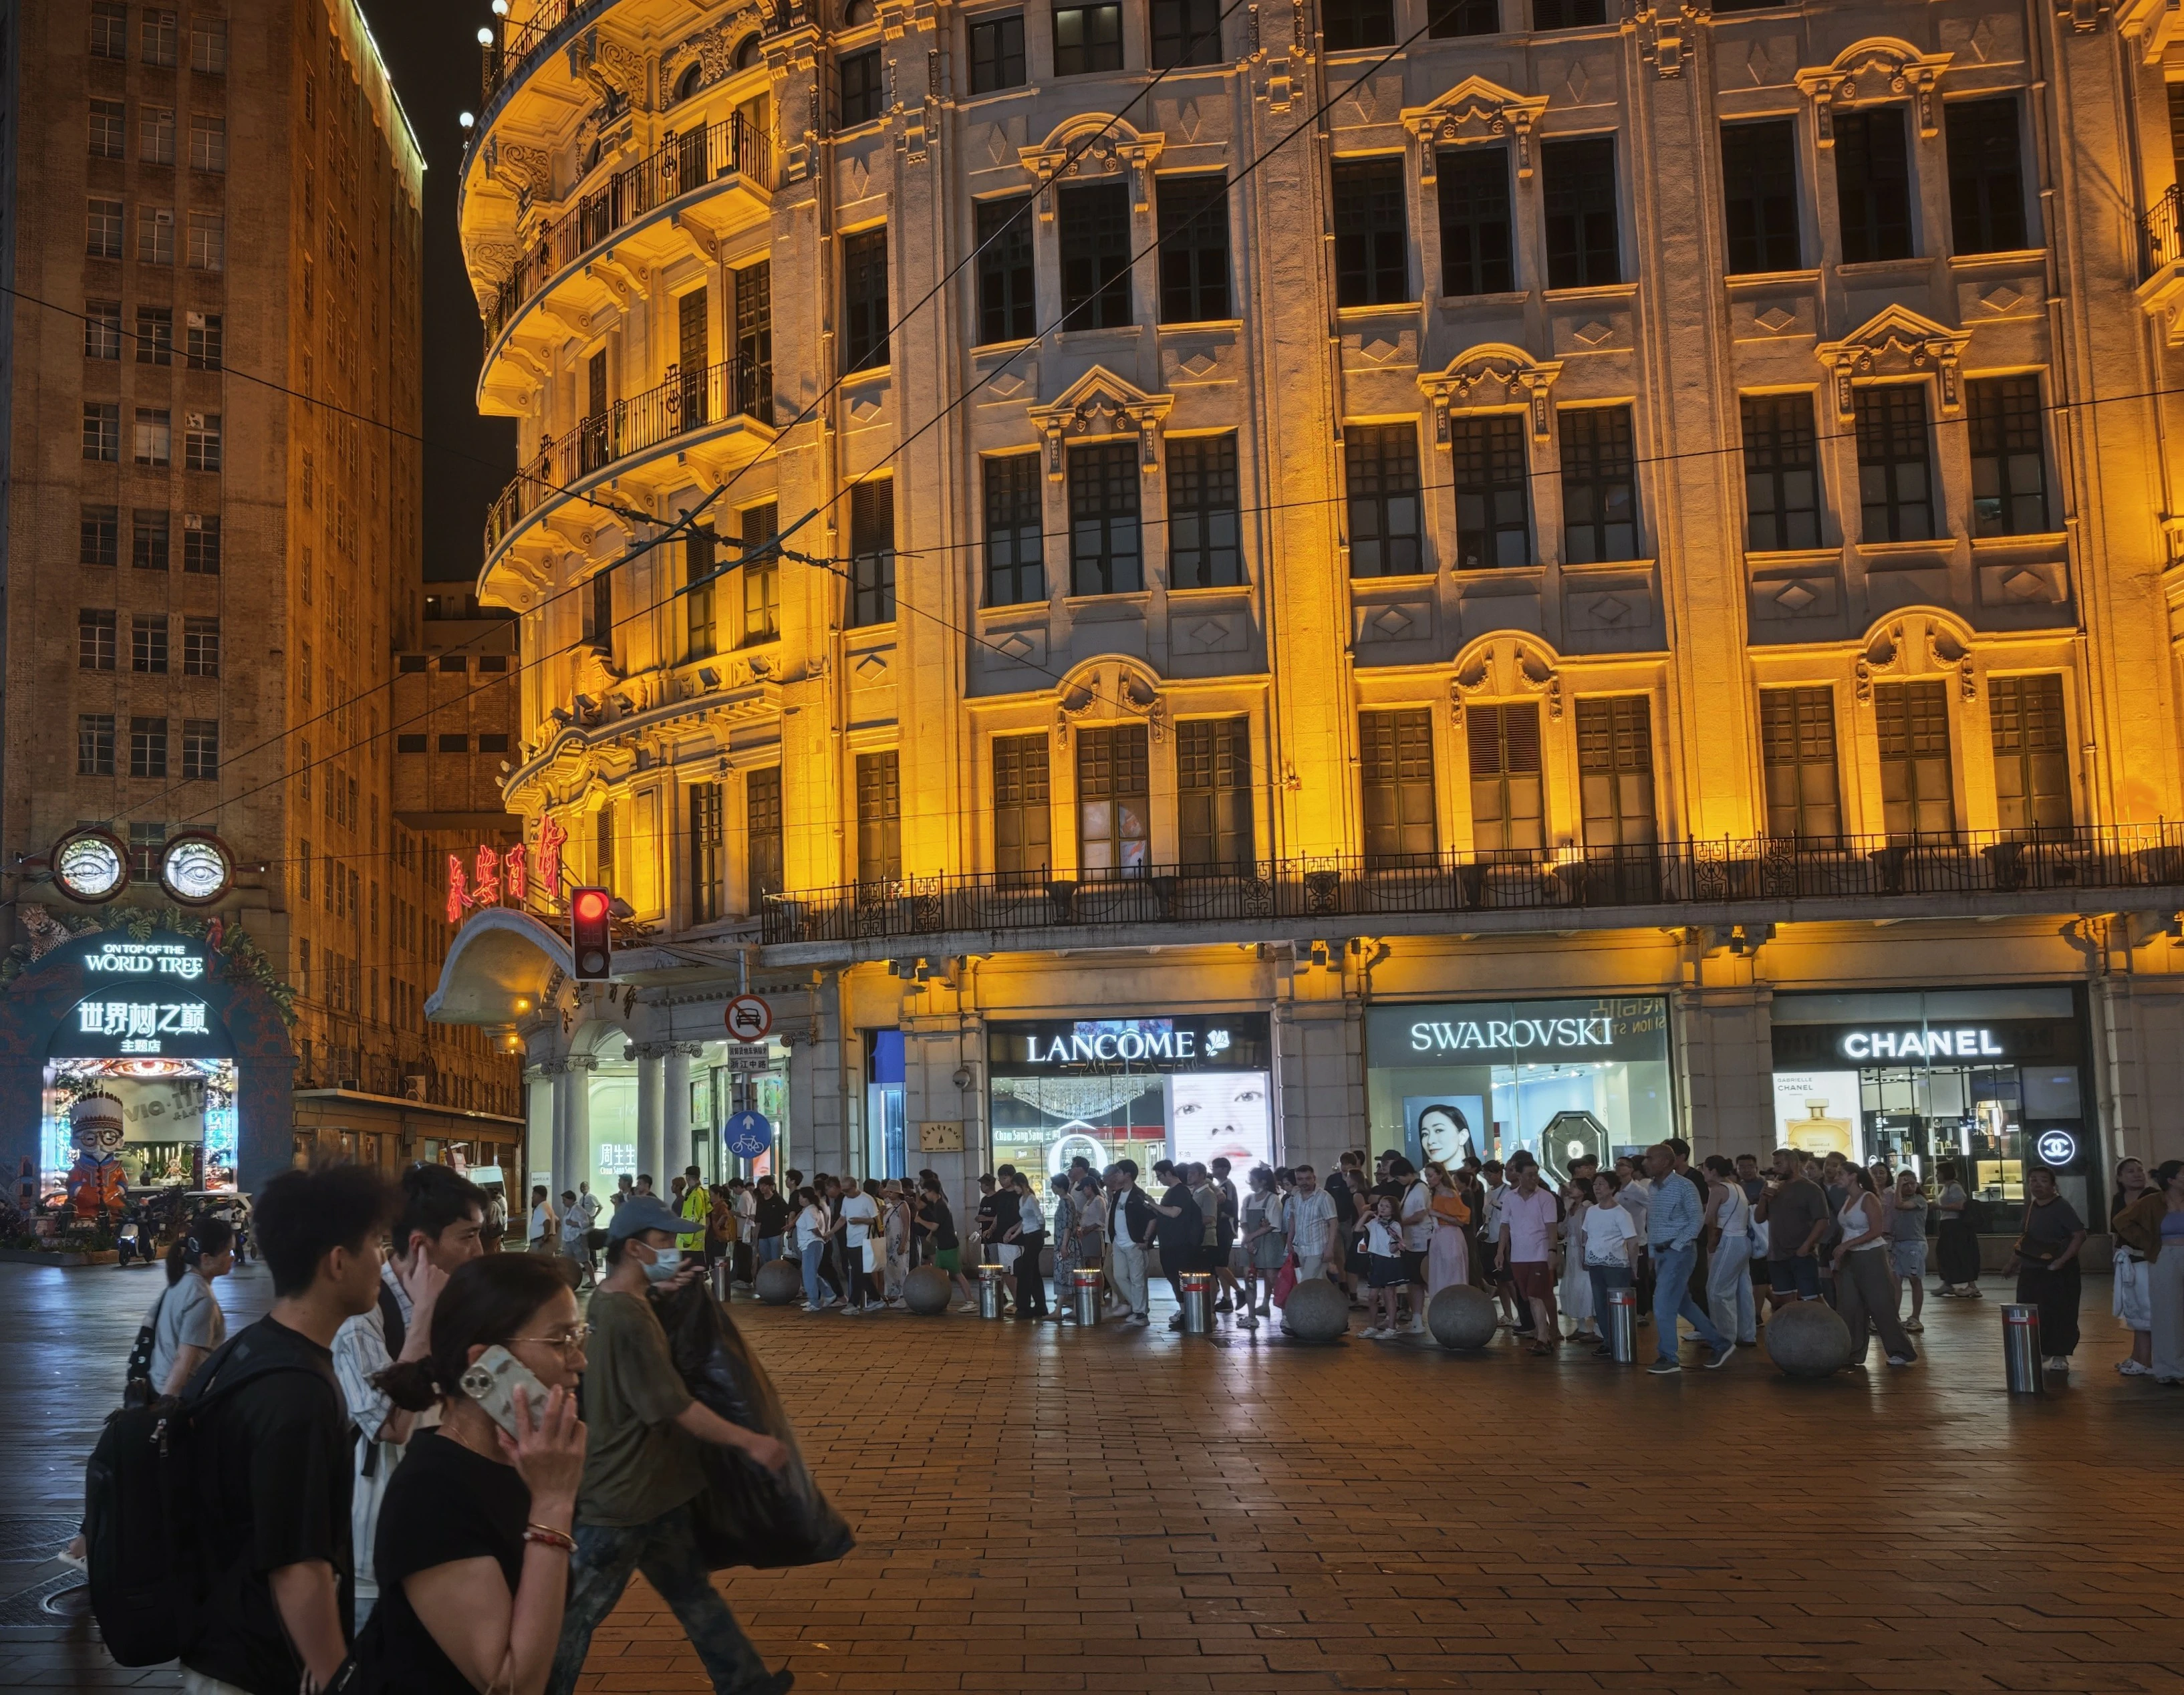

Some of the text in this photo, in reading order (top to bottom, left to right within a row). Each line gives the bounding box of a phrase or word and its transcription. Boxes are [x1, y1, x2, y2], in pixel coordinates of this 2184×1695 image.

[104, 944, 186, 955] ON TOP OF THE
[85, 954, 203, 979] WORLD TREE
[78, 1002, 209, 1038] 世界树之巅
[1027, 1028, 1195, 1062] LANCÔME
[1411, 1017, 1613, 1051] SWAROVSKI
[1844, 1030, 2002, 1057] CHANEL
[120, 1039, 161, 1053] 主题店
[730, 1060, 766, 1069] 浙江中路
[994, 1130, 1012, 1142] Chow
[1012, 1130, 1028, 1143] Sang
[599, 1144, 636, 1166] 周生生
